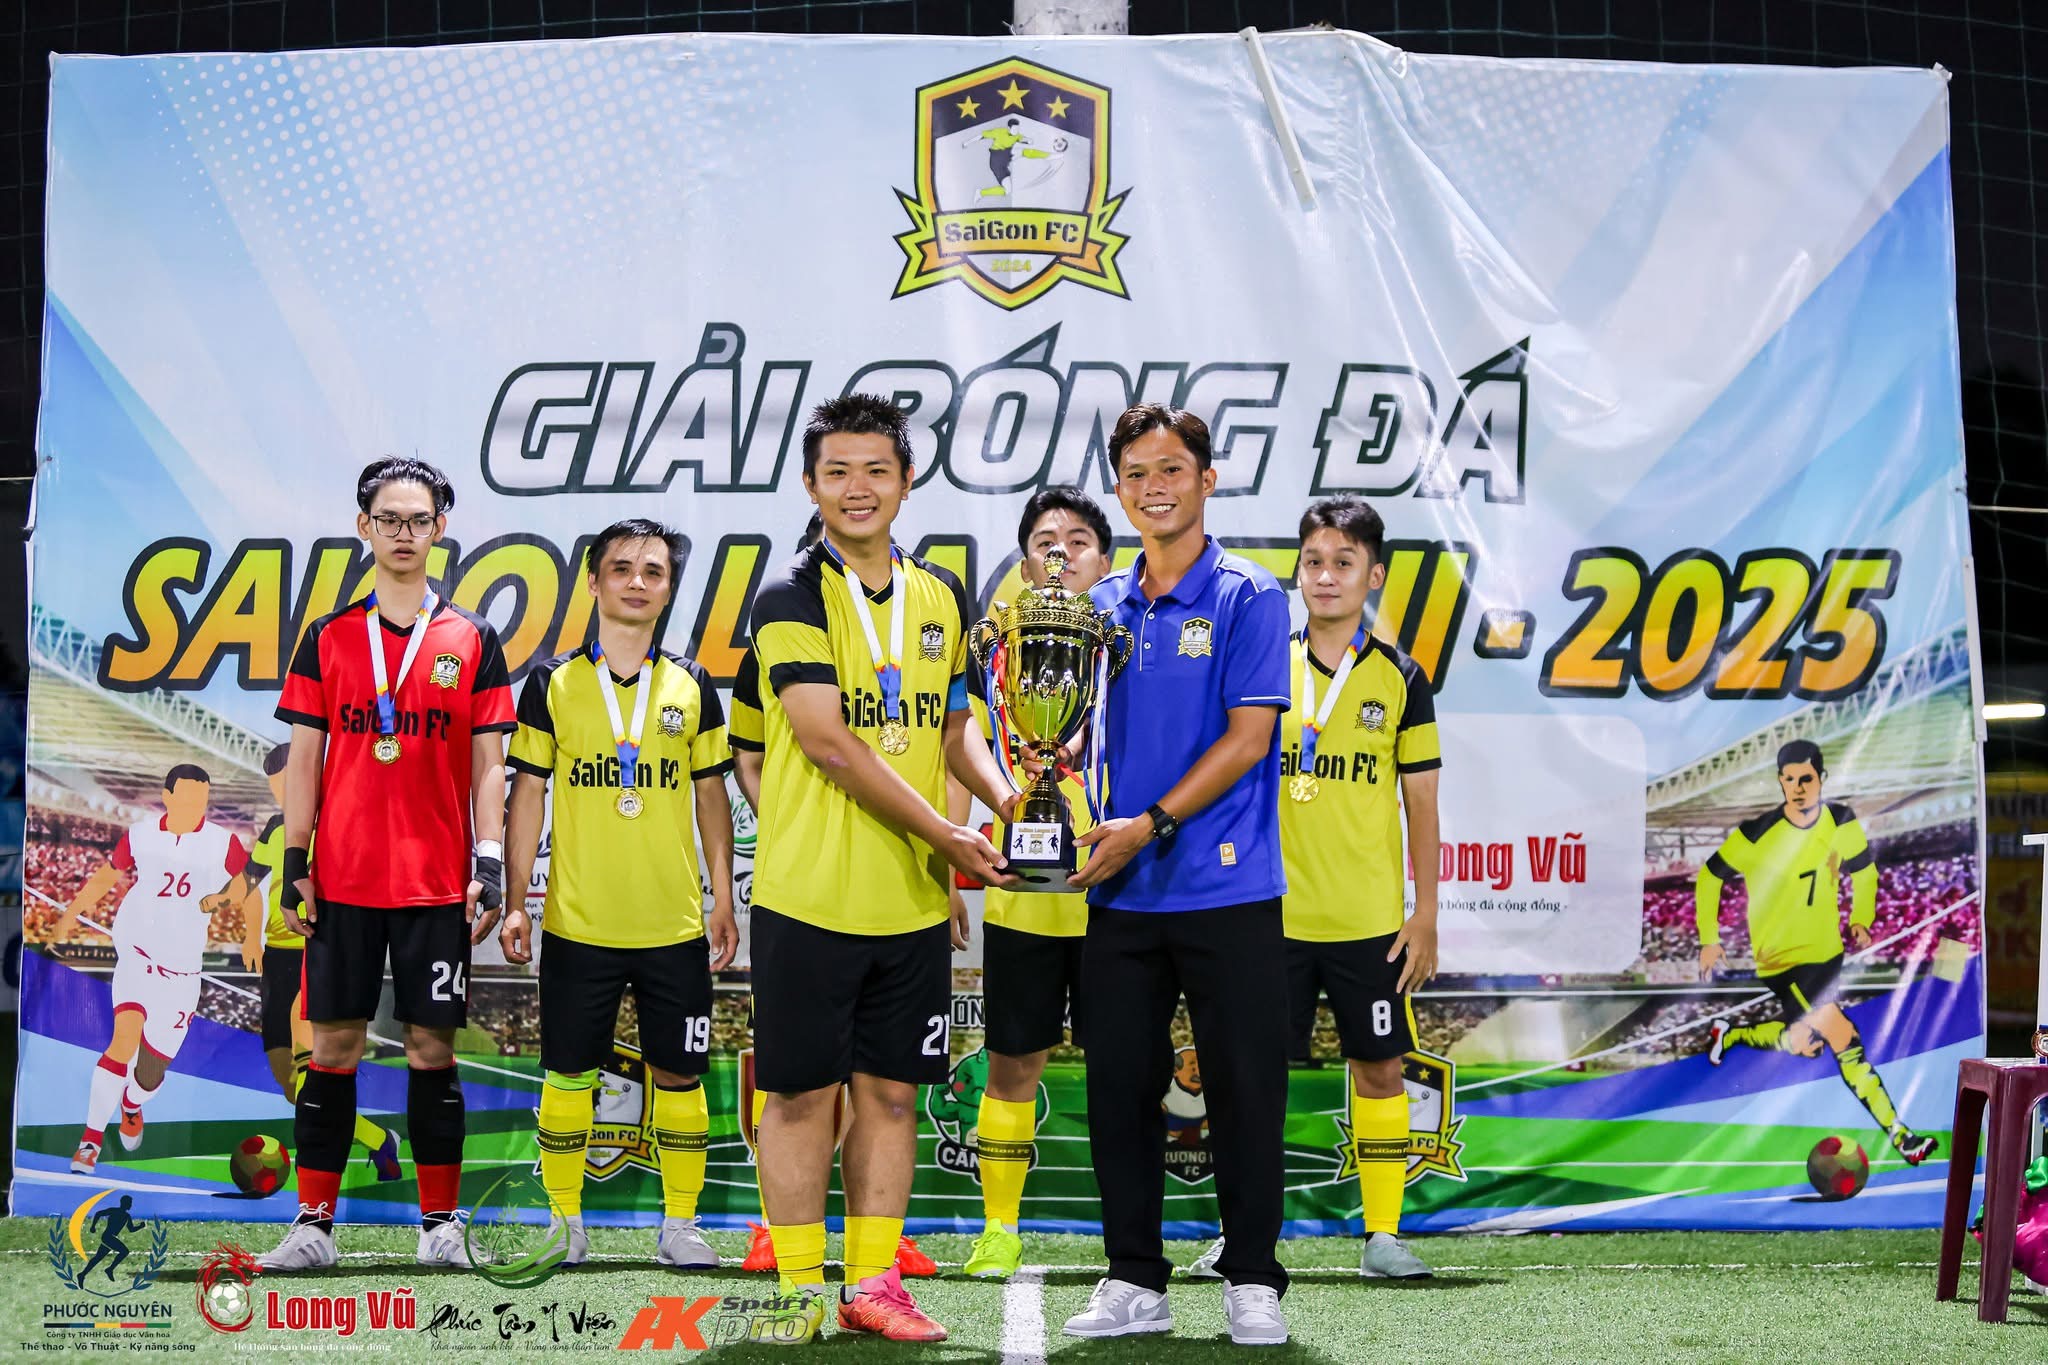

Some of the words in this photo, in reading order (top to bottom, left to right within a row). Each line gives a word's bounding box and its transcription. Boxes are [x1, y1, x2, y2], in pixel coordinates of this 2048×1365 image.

[945, 219, 1038, 243] SaiGon
[1045, 221, 1080, 244] FC
[481, 322, 812, 494] GIẢI
[1309, 336, 1531, 505] ĐÁ
[1538, 546, 1902, 702] 2025
[915, 692, 942, 729] FC
[1351, 752, 1378, 784] FC
[1527, 832, 1587, 883] Vũ
[157, 871, 192, 898] 26
[1799, 869, 1818, 907] 7
[432, 961, 466, 1002] 24
[685, 1016, 711, 1052] 19
[1371, 1000, 1392, 1036] 8
[618, 1129, 636, 1141] FC
[1417, 1136, 1435, 1149] FC
[1184, 1166, 1200, 1176] FC
